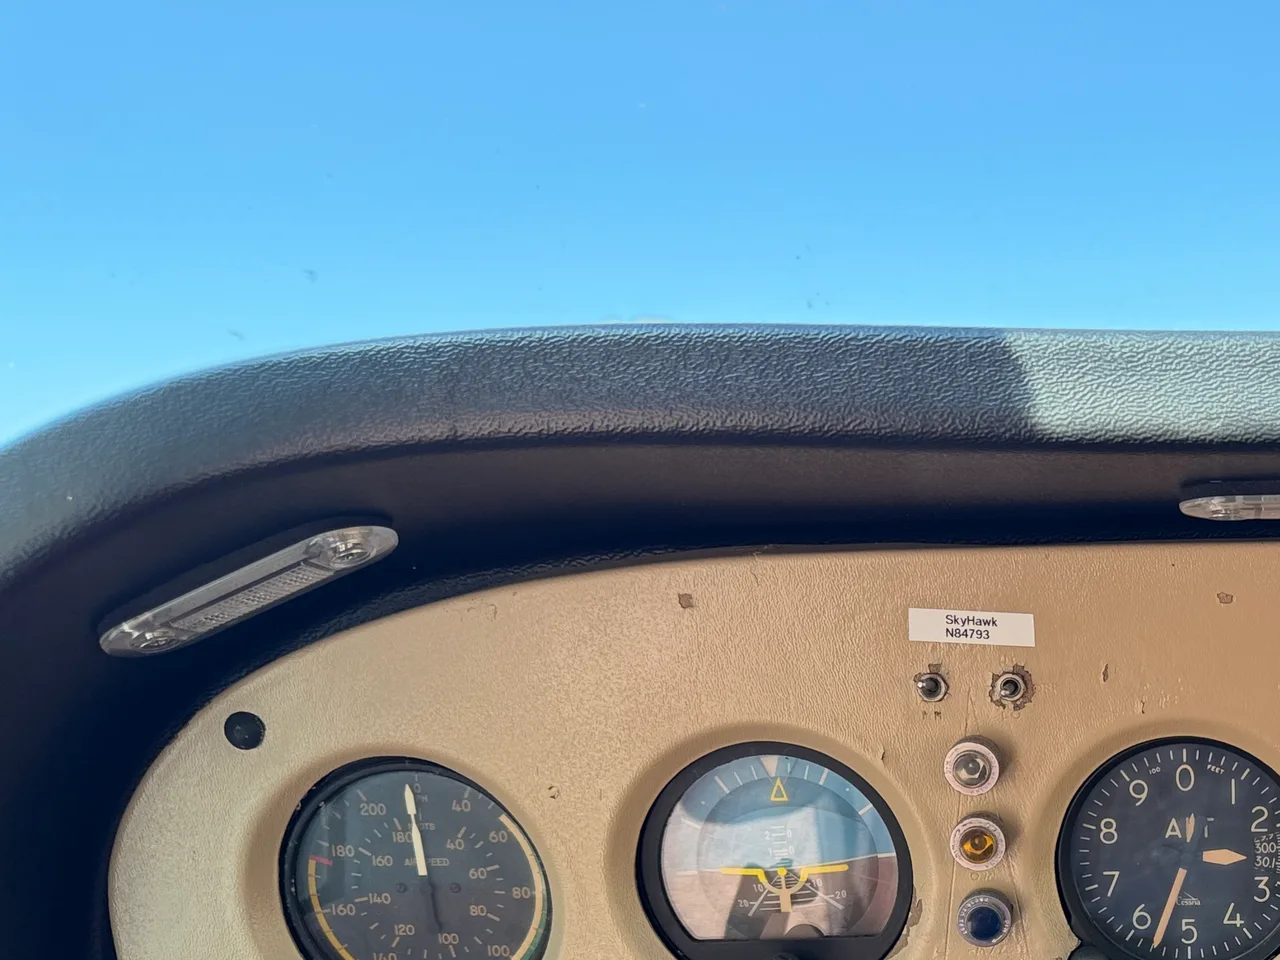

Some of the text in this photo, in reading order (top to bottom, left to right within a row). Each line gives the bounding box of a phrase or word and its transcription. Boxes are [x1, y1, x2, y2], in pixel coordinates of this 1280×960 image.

[946, 615, 997, 627] SkyHawk
[946, 628, 990, 639] N84793
[1208, 765, 1224, 774] FEET
[1176, 764, 1194, 791] 0
[360, 804, 386, 815] 200
[1251, 806, 1269, 832] 2
[1100, 818, 1117, 844] 8
[332, 846, 354, 857] 180
[1103, 871, 1120, 896] 7
[1254, 876, 1270, 902] 3
[512, 887, 530, 898] 80
[332, 904, 356, 916] 160
[1181, 919, 1197, 944] 5
[488, 946, 510, 956] 100
